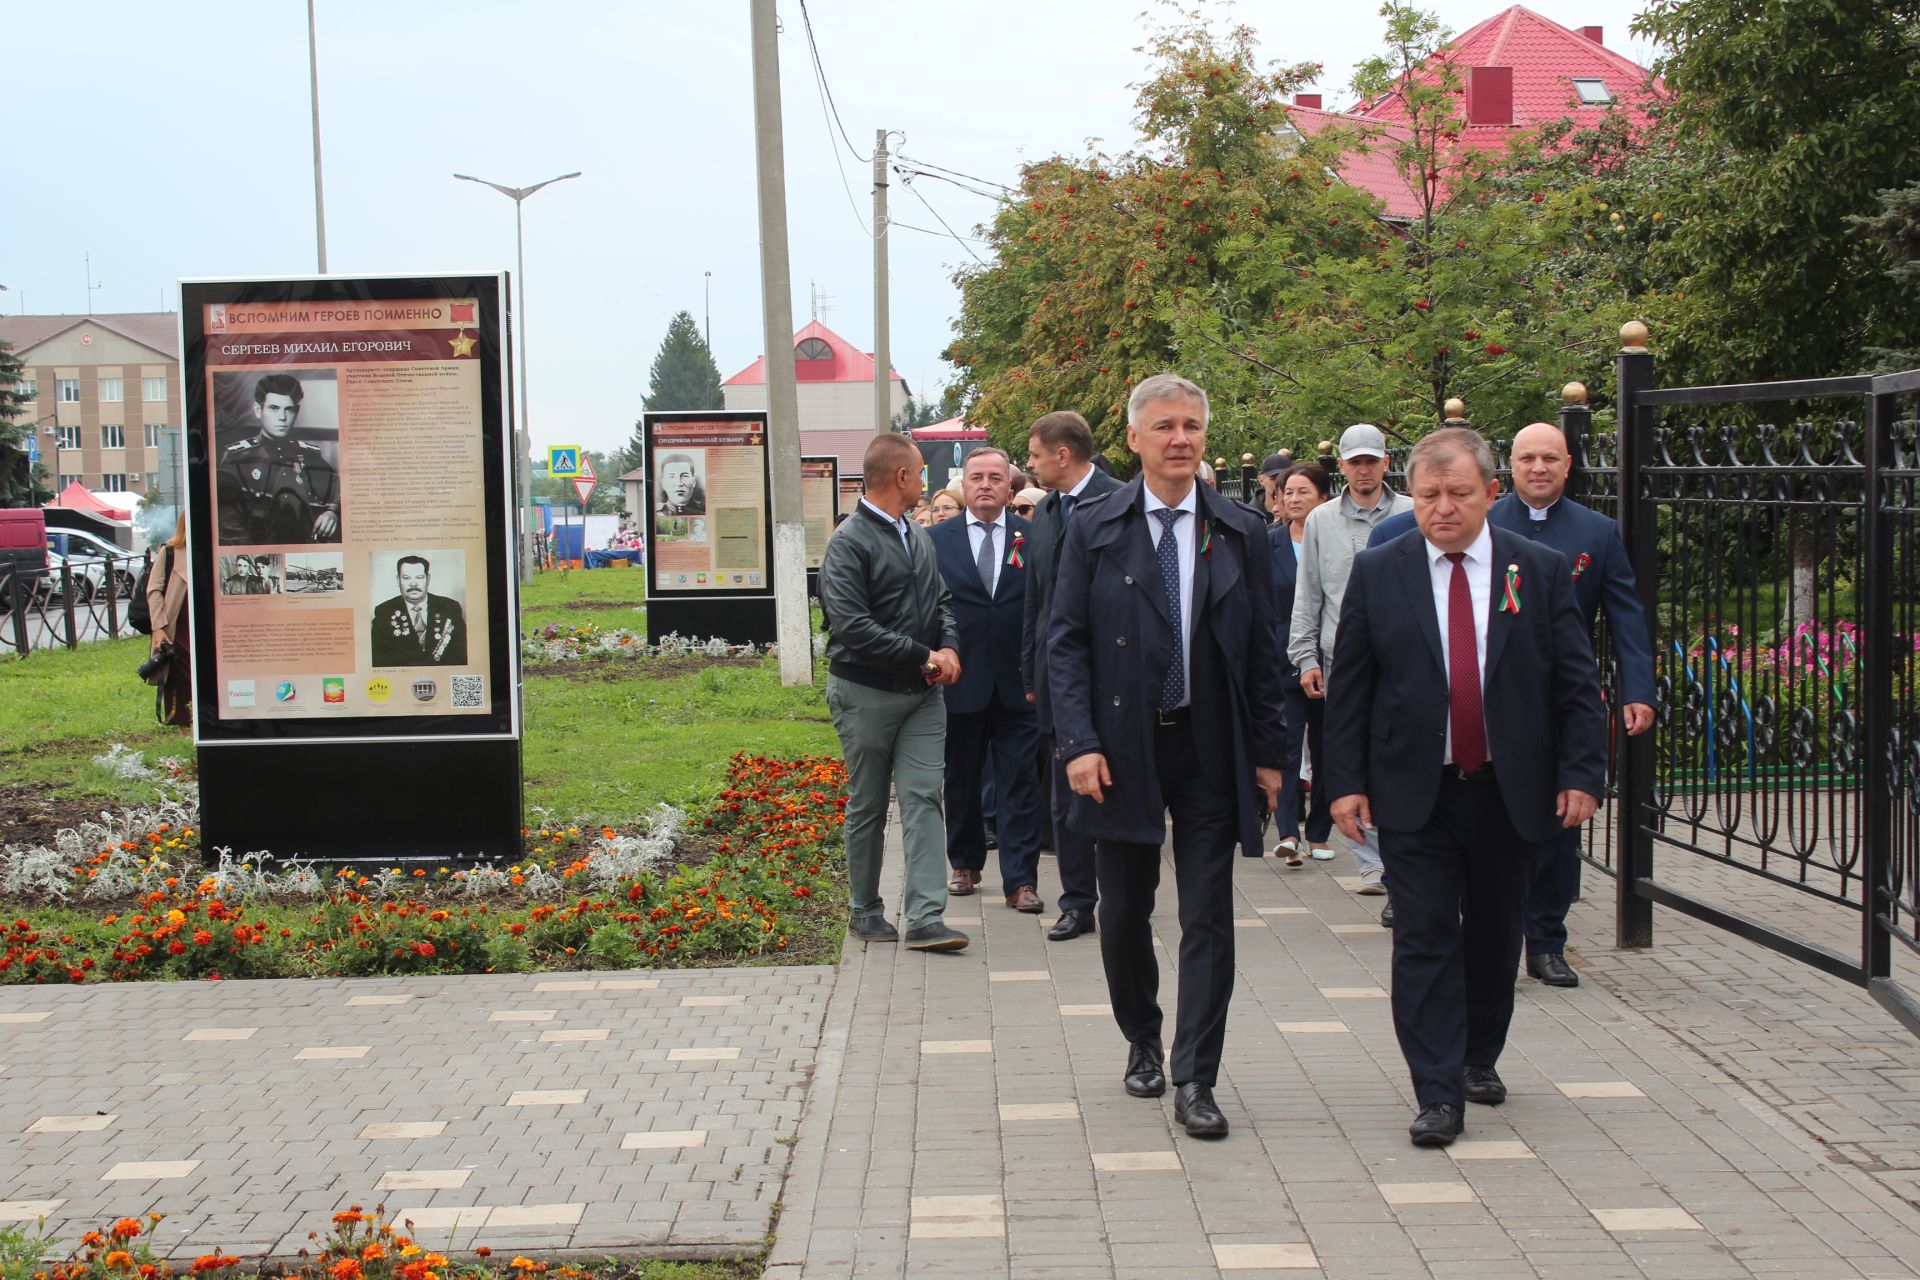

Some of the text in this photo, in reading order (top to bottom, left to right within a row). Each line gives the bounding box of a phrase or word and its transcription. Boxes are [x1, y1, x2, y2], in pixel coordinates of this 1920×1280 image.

[229, 308, 442, 325] ВСПОМНИМ ГЕРОЕВ ПОИМЕННО
[222, 341, 411, 355] СЕРГЕЕВ МИХАИЛ ЕГОРОВИЧ
